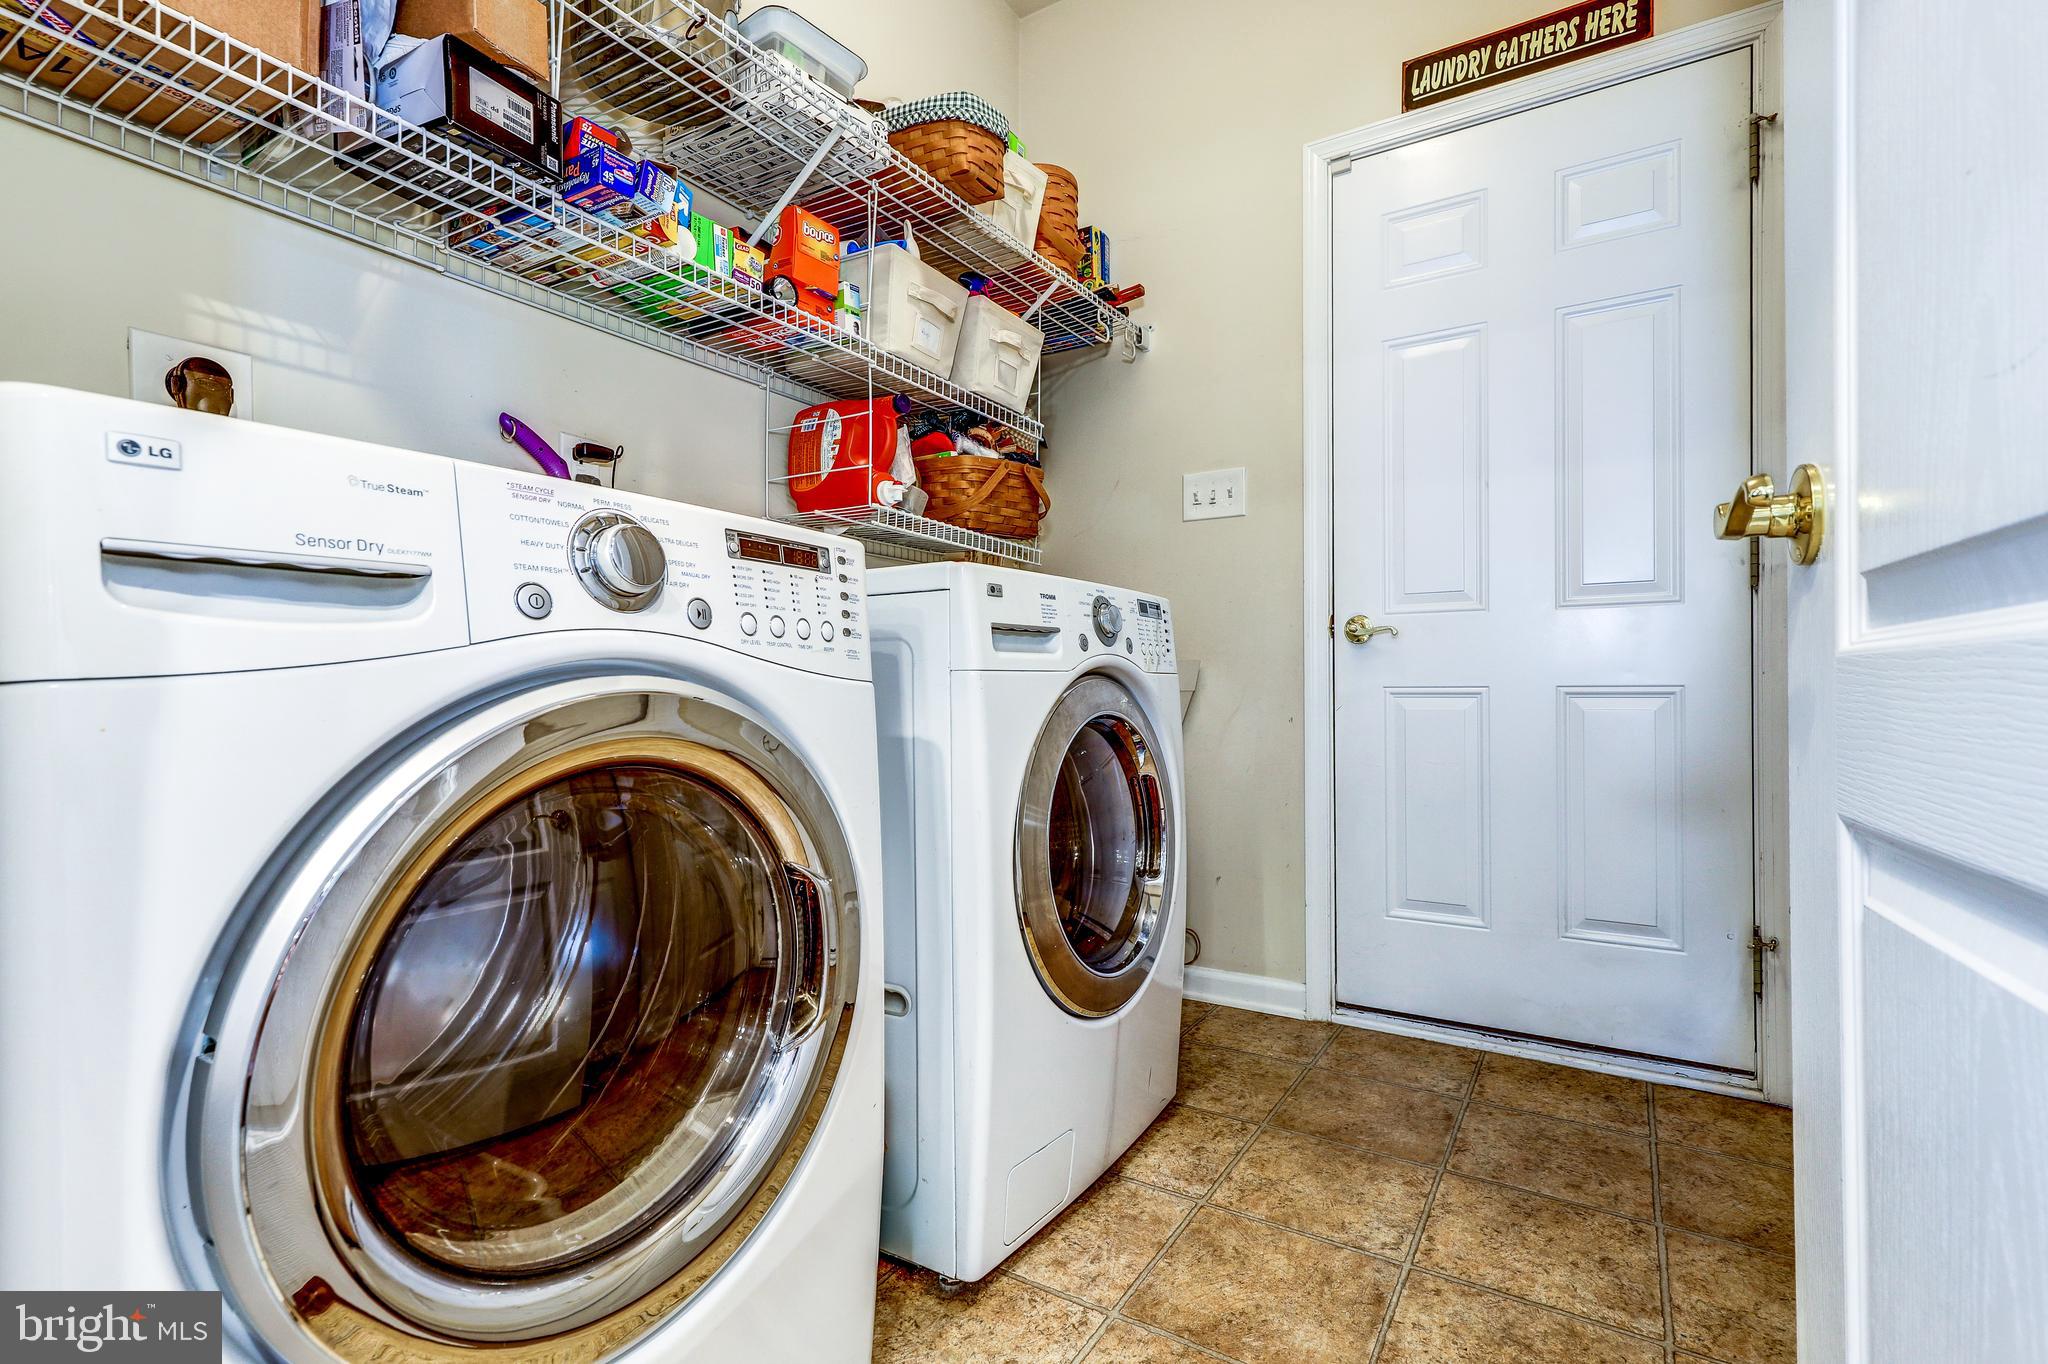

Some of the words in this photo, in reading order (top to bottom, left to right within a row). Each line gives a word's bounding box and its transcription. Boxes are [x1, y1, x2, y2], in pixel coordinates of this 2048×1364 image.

[1410, 44, 1493, 97] LAUNDRY
[1494, 16, 1580, 70] GATHERS
[1584, 0, 1639, 43] HERE
[550, 101, 558, 144] Panasonic
[602, 170, 615, 181] 45
[803, 221, 836, 244] bounce
[736, 243, 750, 253] GLAD
[750, 280, 761, 291] 50
[148, 445, 173, 459] LG
[534, 486, 555, 496] CYCLE
[511, 492, 538, 502] SENSOR
[538, 496, 551, 504] DRY
[557, 500, 586, 511] NORMAL
[613, 501, 632, 511] PRESS
[639, 515, 670, 526] DELICATES
[295, 532, 352, 552] Sensor
[357, 538, 384, 556] Dry
[520, 539, 544, 548] HEAVY
[545, 542, 565, 550] DUTY
[675, 539, 700, 549] DELICATE
[513, 563, 539, 573] STEAM
[668, 559, 685, 567] SPEED
[681, 571, 701, 579] MANUAL
